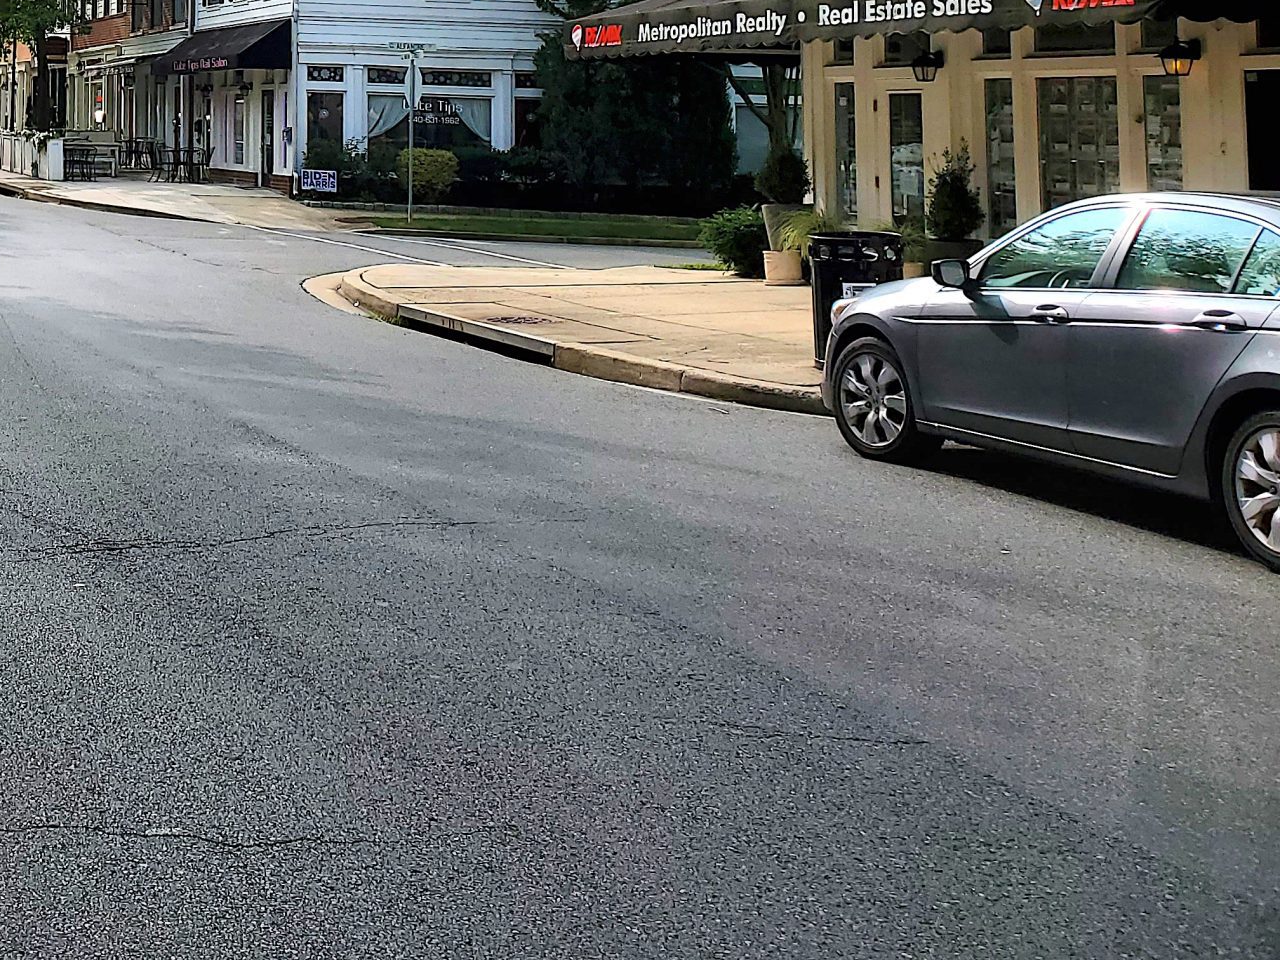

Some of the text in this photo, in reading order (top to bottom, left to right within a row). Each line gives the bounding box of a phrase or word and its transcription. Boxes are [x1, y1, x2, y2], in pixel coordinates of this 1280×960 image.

[584, 25, 623, 48] RE/MAX
[637, 16, 732, 44] Metropolitan
[735, 10, 787, 36] Realty
[817, 0, 859, 26] Real
[211, 57, 228, 68] Salon
[437, 100, 463, 116] Tips
[302, 170, 336, 181] BIDEN
[302, 180, 336, 189] HARRIS
